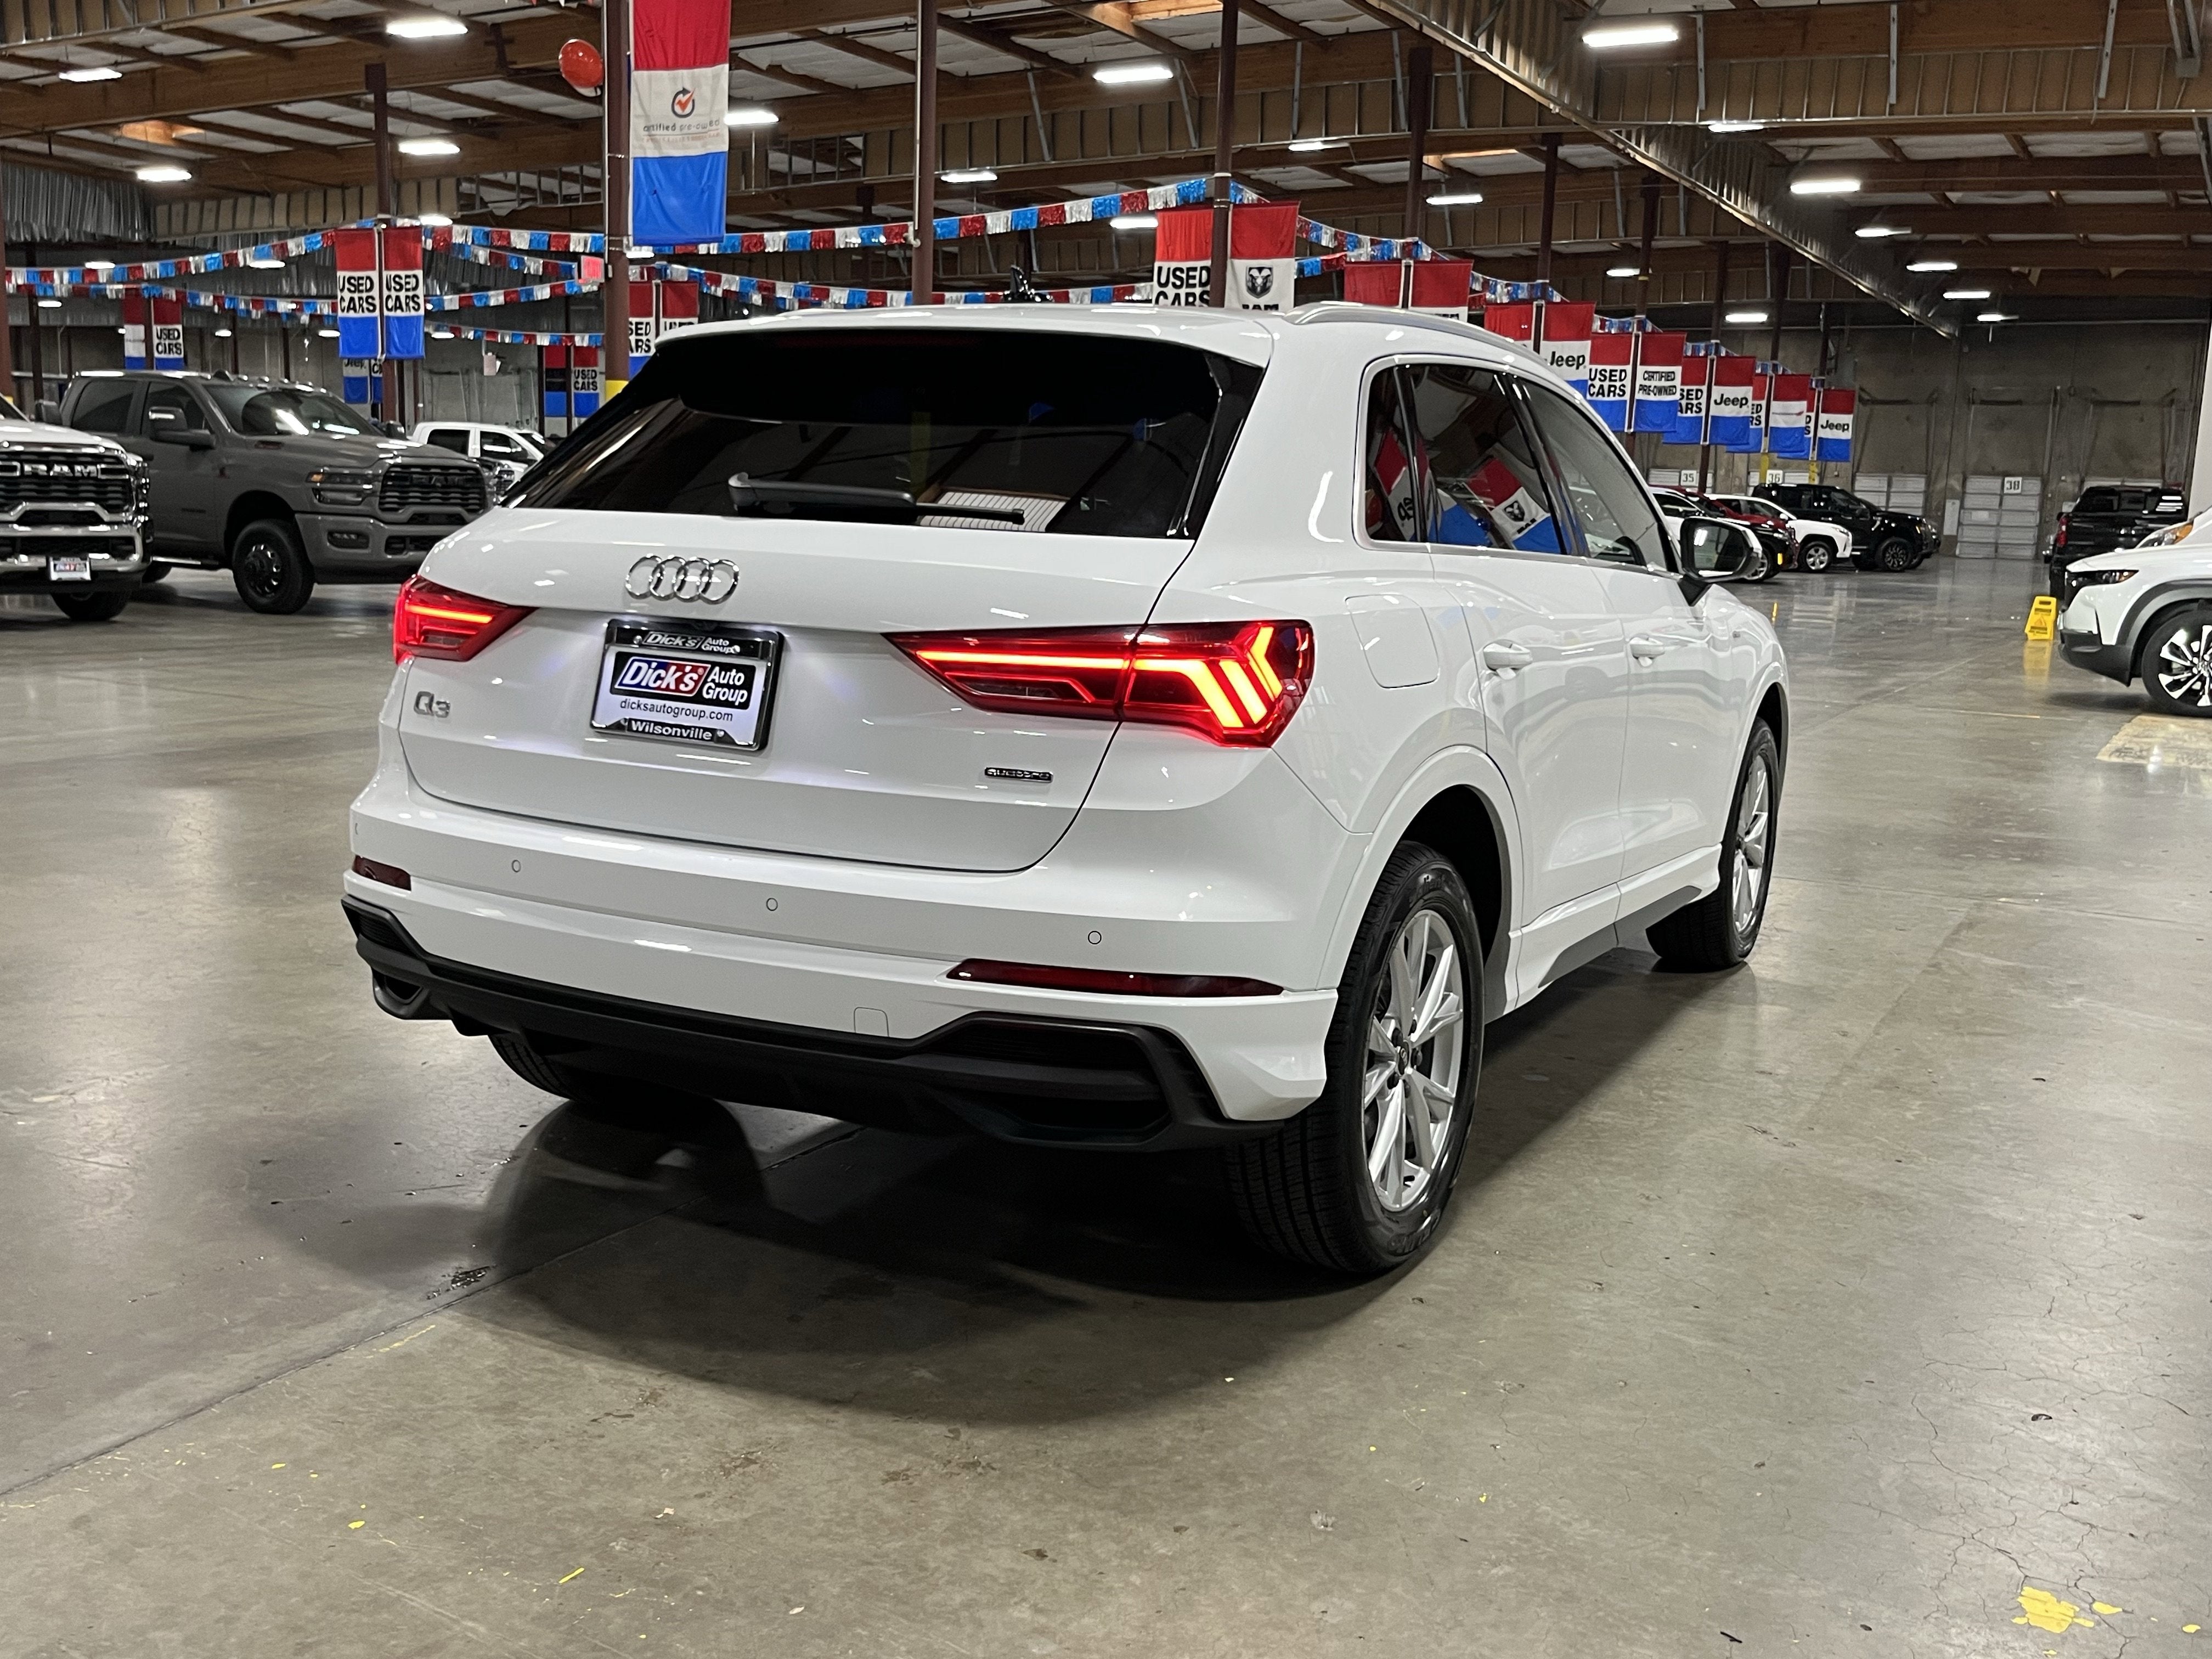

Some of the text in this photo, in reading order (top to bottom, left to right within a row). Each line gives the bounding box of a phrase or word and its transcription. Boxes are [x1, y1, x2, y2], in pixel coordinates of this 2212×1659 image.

[338, 275, 374, 294] USED
[386, 274, 419, 292] USED
[1157, 266, 1211, 289] USED
[340, 295, 377, 313] CARS
[385, 294, 420, 312] CARS
[156, 328, 180, 340] USED
[629, 321, 651, 336] SED
[1544, 351, 1585, 370] Jeep
[1589, 368, 1627, 382] USED
[1588, 383, 1626, 397] CARS
[1679, 388, 1703, 400] SED
[1714, 393, 1748, 408] Jeep
[1820, 420, 1849, 432] Jeep
[24, 464, 98, 477] RAM
[1683, 473, 1694, 482] 35
[1768, 473, 1780, 483] 36
[646, 634, 730, 647] Dick's Auto
[702, 645, 735, 654] Group
[622, 661, 745, 692] Dick's Auto
[702, 682, 748, 706] Group
[414, 691, 450, 718] Q3
[620, 698, 733, 721] dicksautogroup.com
[631, 720, 713, 740] Wilsonville
